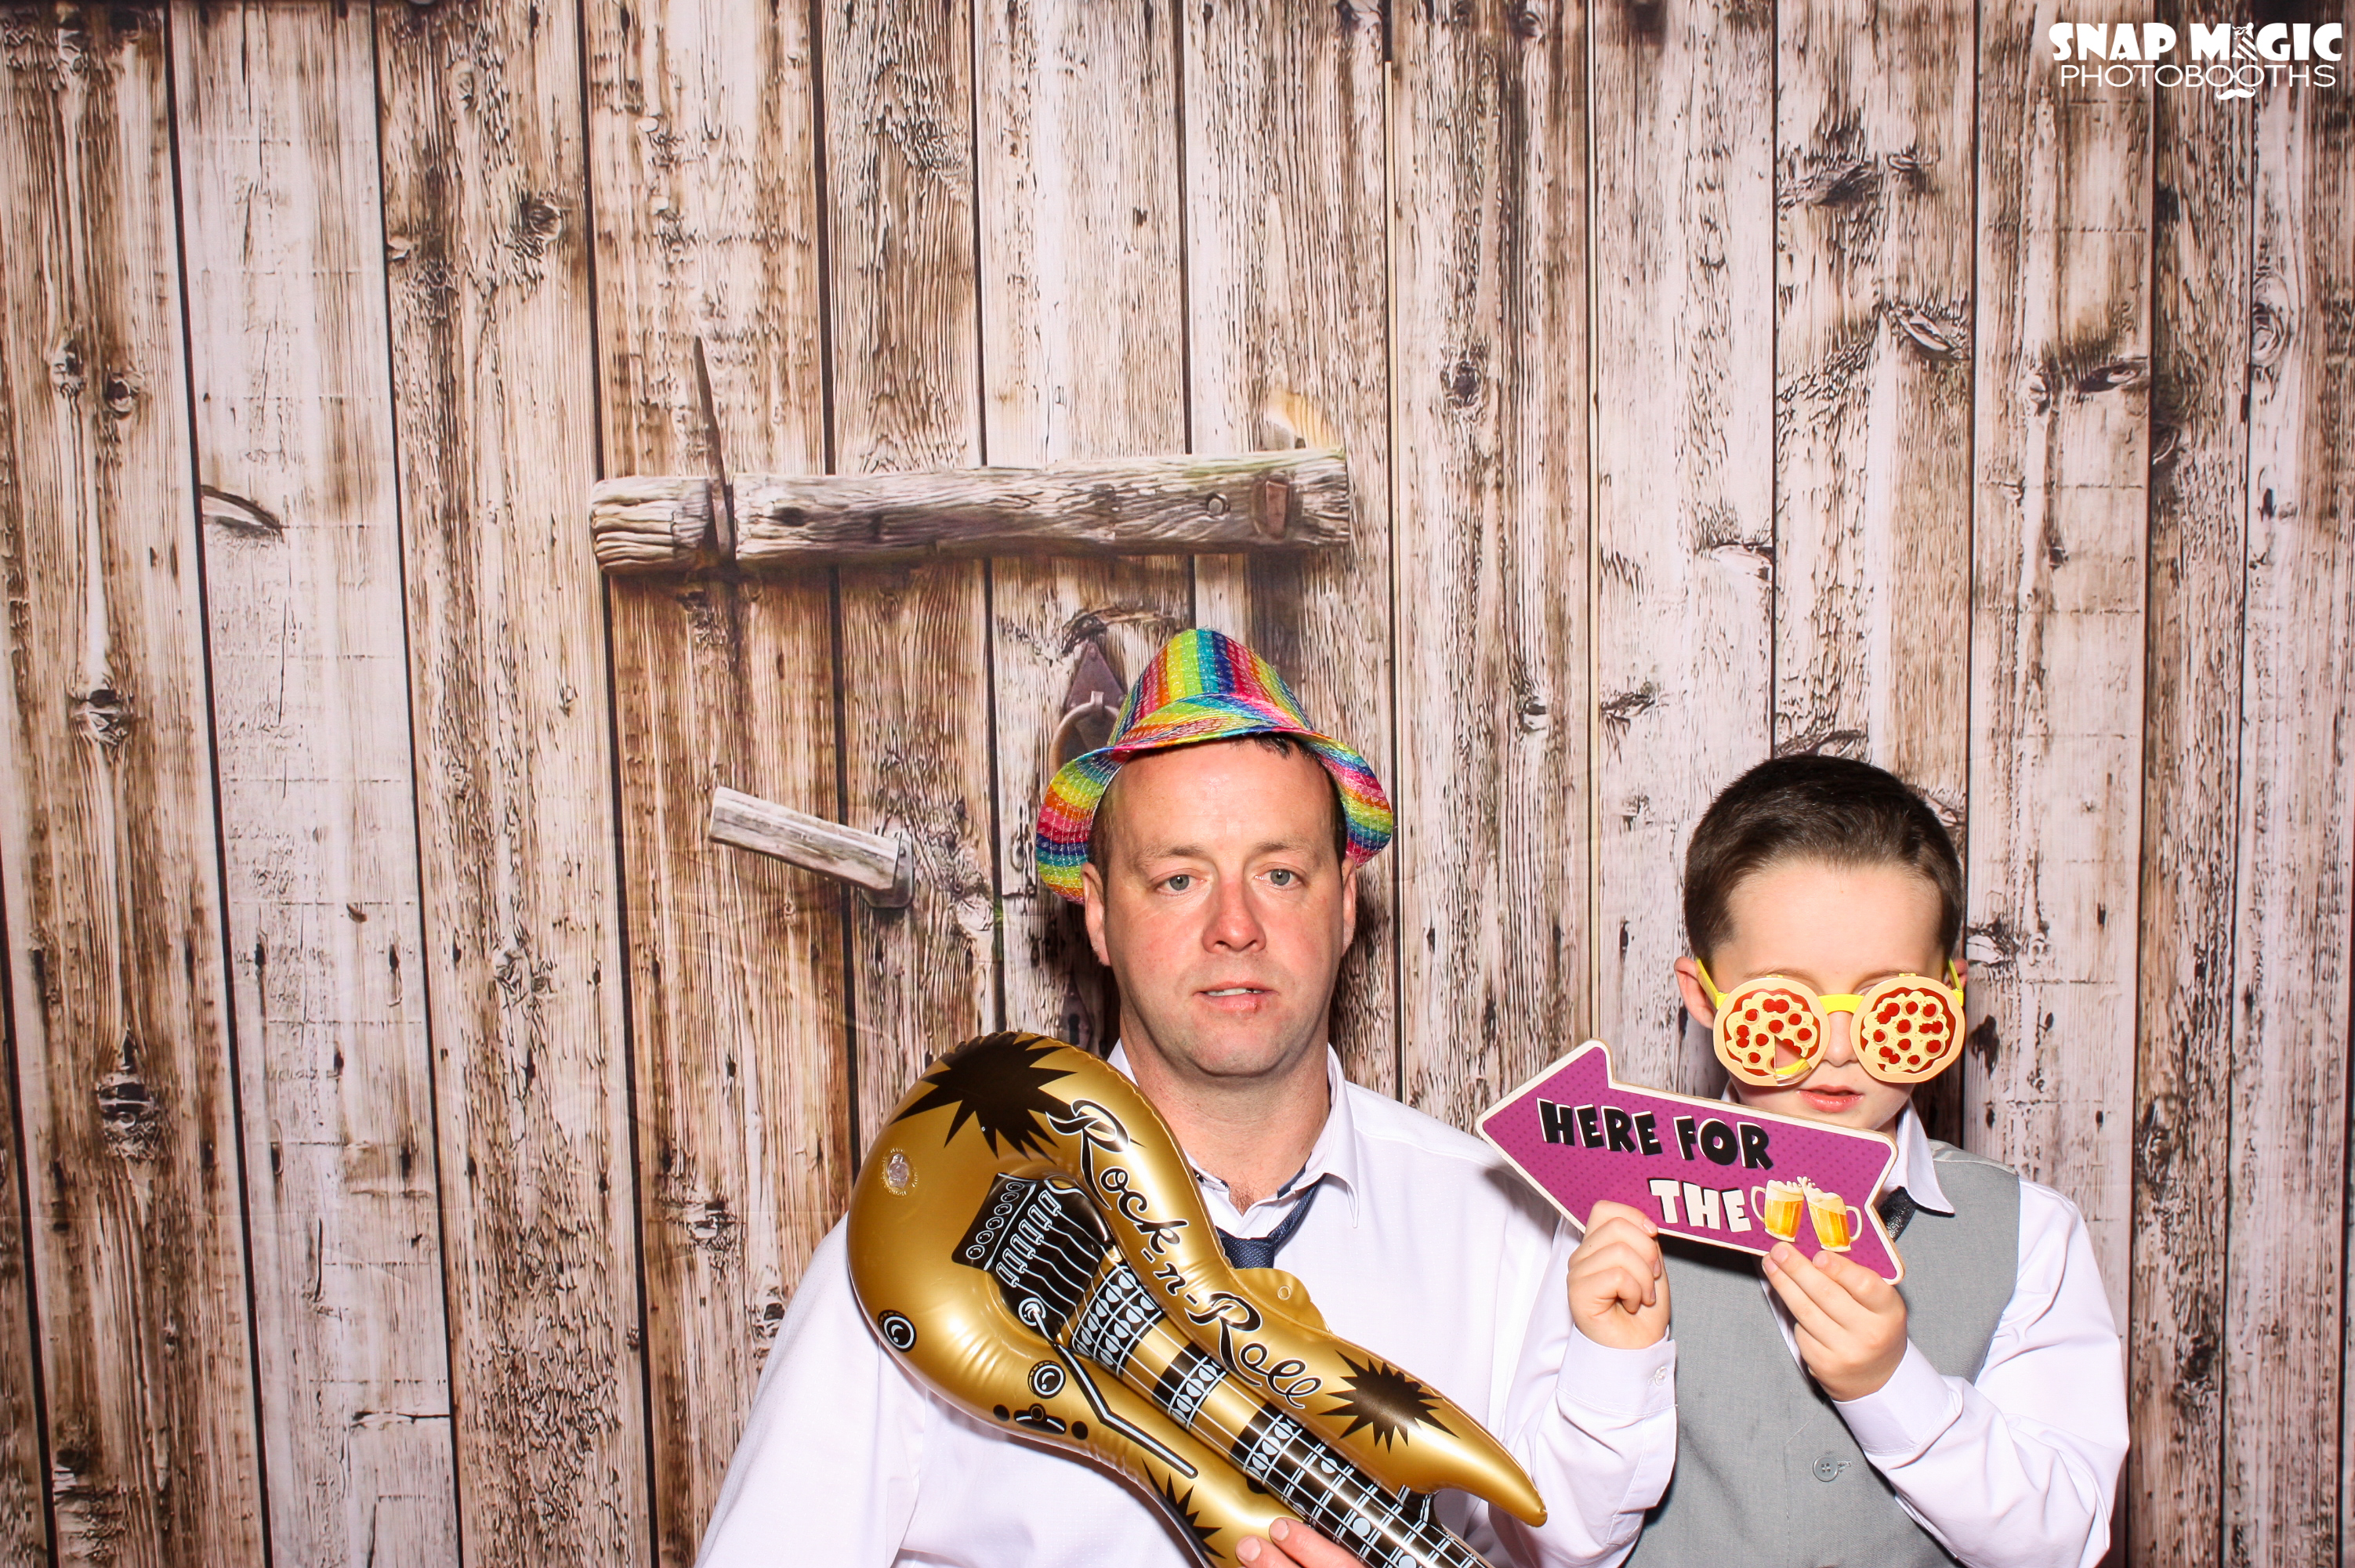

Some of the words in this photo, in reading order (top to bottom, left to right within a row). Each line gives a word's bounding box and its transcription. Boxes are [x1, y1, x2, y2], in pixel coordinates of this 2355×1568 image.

[1537, 1097, 1662, 1156] HERE
[1673, 1114, 1773, 1170] FOR
[1649, 1178, 1752, 1233] THE
